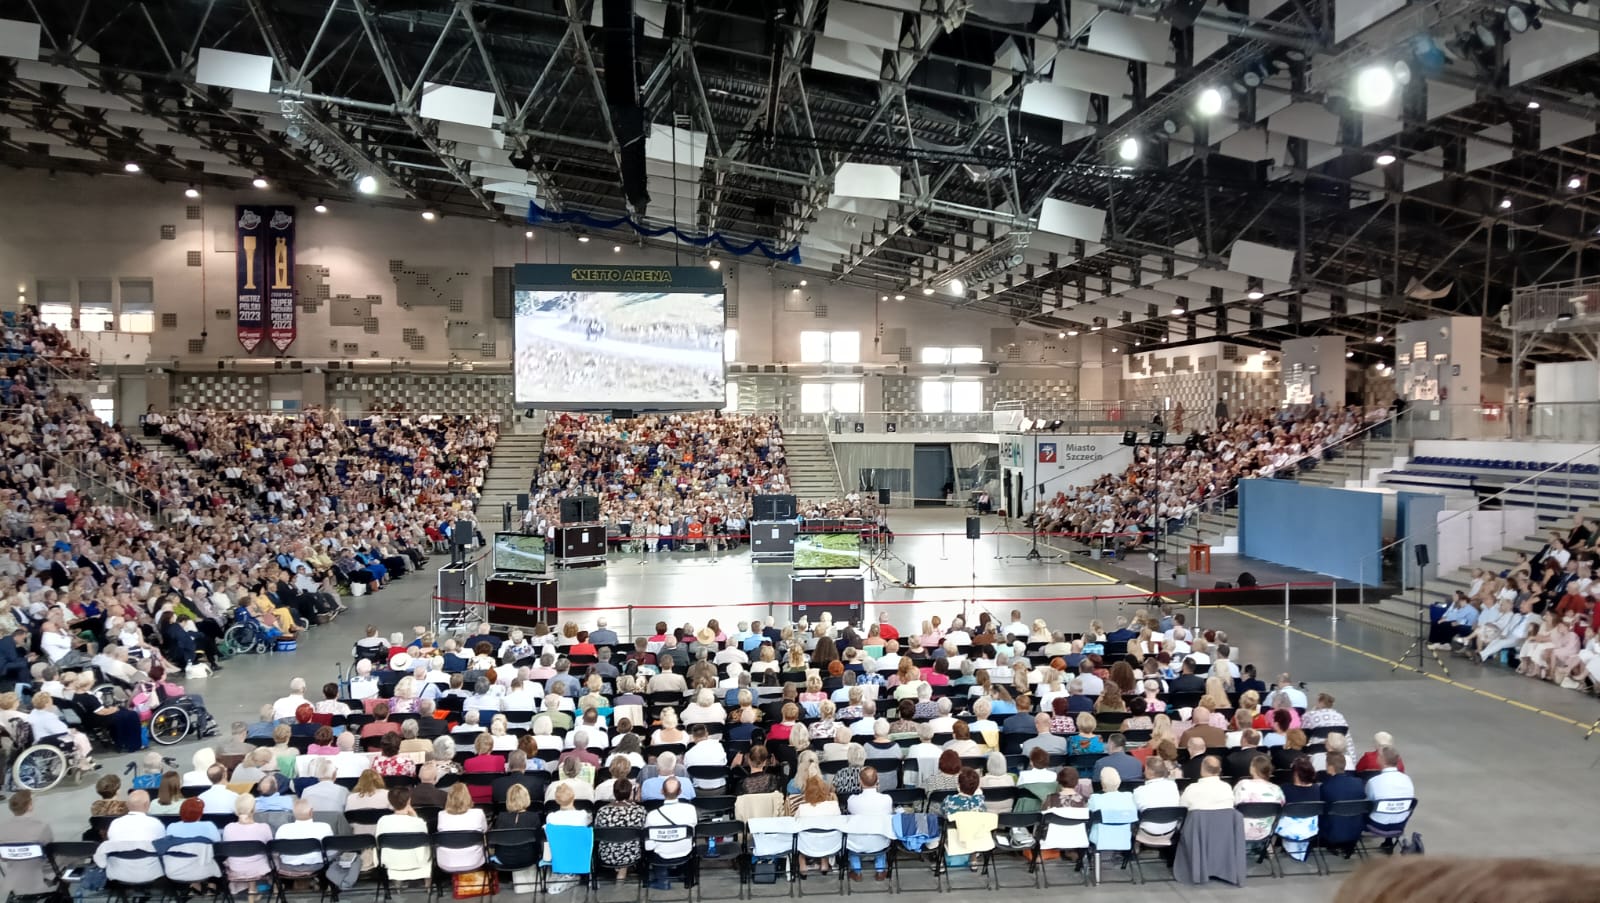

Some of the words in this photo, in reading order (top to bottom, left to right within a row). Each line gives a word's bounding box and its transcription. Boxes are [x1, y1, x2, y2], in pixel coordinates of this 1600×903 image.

[577, 269, 620, 281] NETTO
[624, 270, 672, 282] ARENA
[239, 311, 260, 320] 2023
[272, 321, 292, 329] 2023
[1066, 443, 1096, 452] Miasto
[1066, 452, 1103, 460] Szczecin
